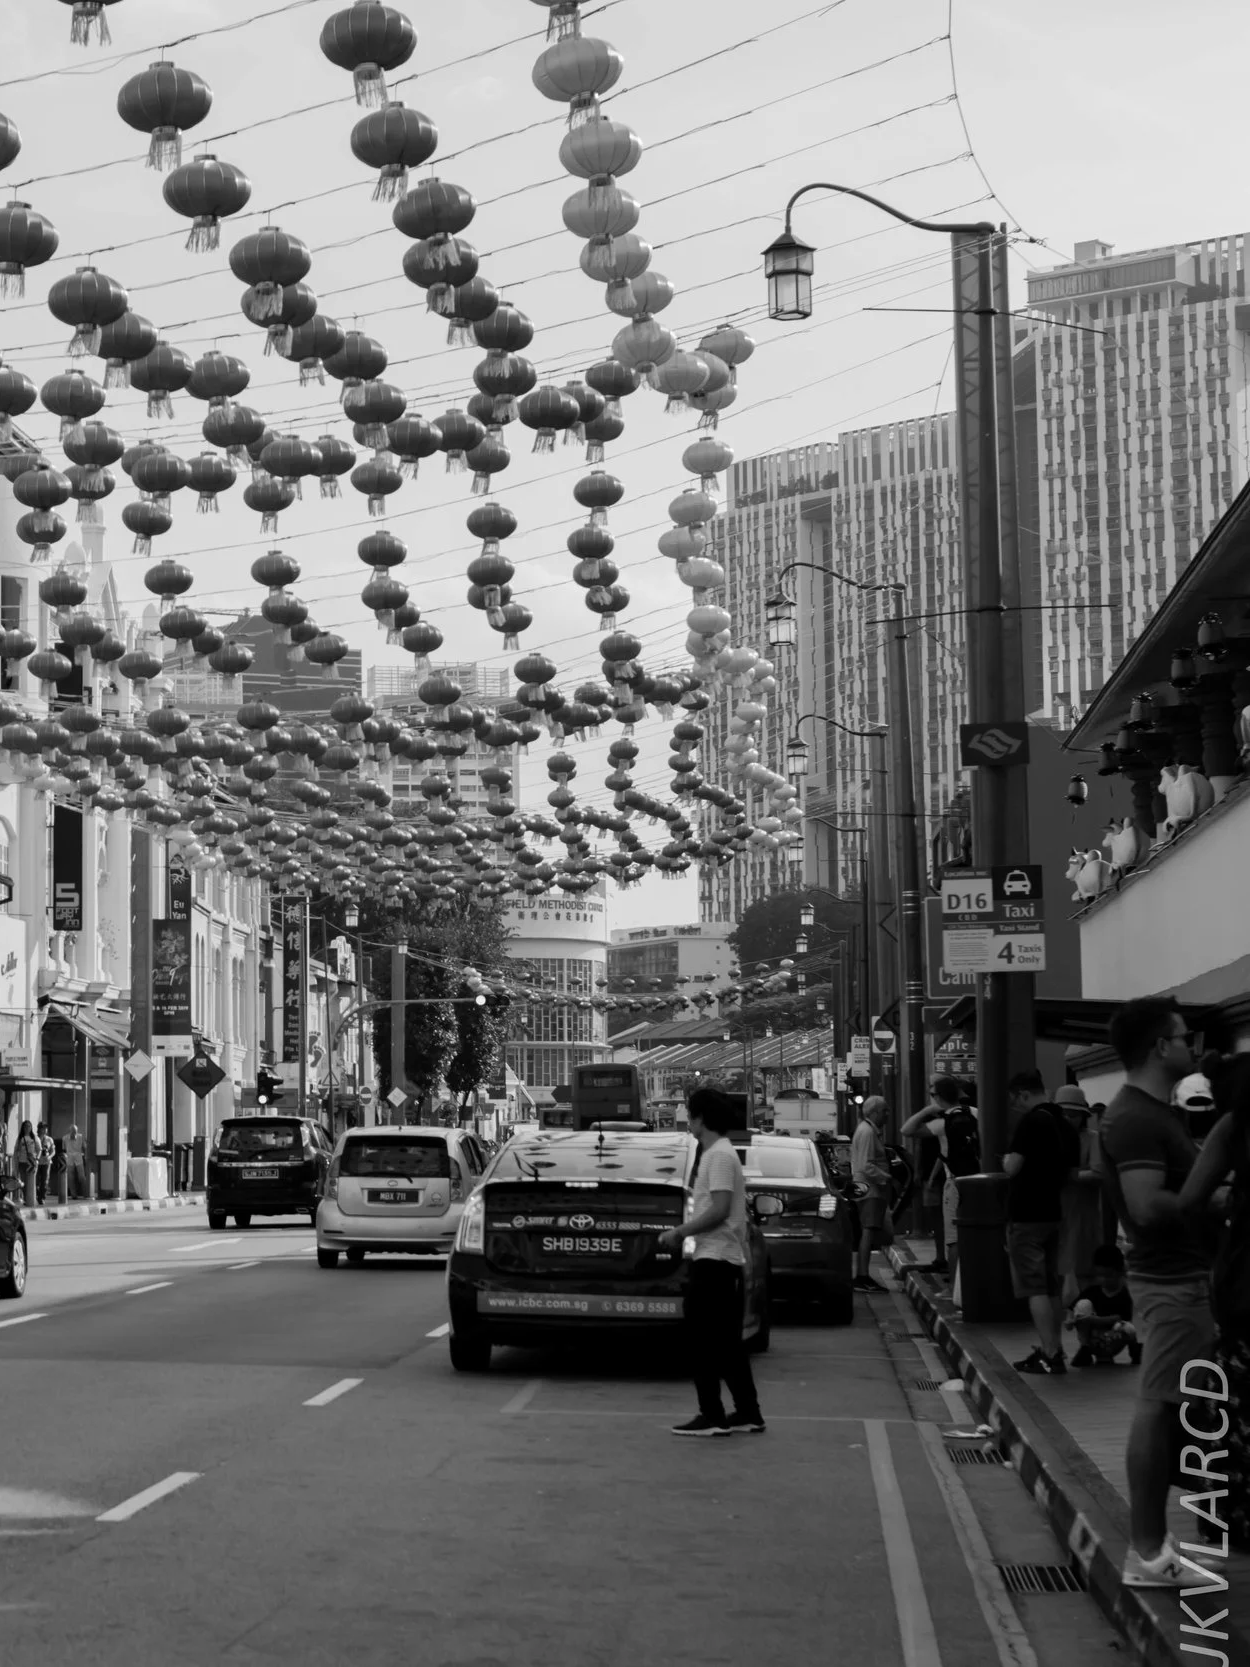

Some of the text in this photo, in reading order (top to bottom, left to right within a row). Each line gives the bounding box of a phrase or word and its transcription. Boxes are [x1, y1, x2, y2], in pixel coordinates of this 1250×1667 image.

[56, 883, 80, 907] 5
[947, 893, 988, 911] D16
[173, 900, 185, 909] Eu
[539, 900, 587, 911] METHODIST
[1002, 903, 1035, 918] Taxi
[172, 911, 187, 920] Yan
[997, 942, 1015, 965] 4
[1017, 945, 1043, 953] Taxis
[1017, 956, 1041, 965] Only
[542, 1237, 622, 1252] SHB1939E
[488, 1297, 589, 1312] www.icbc.com.sg
[616, 1301, 645, 1313] 6369
